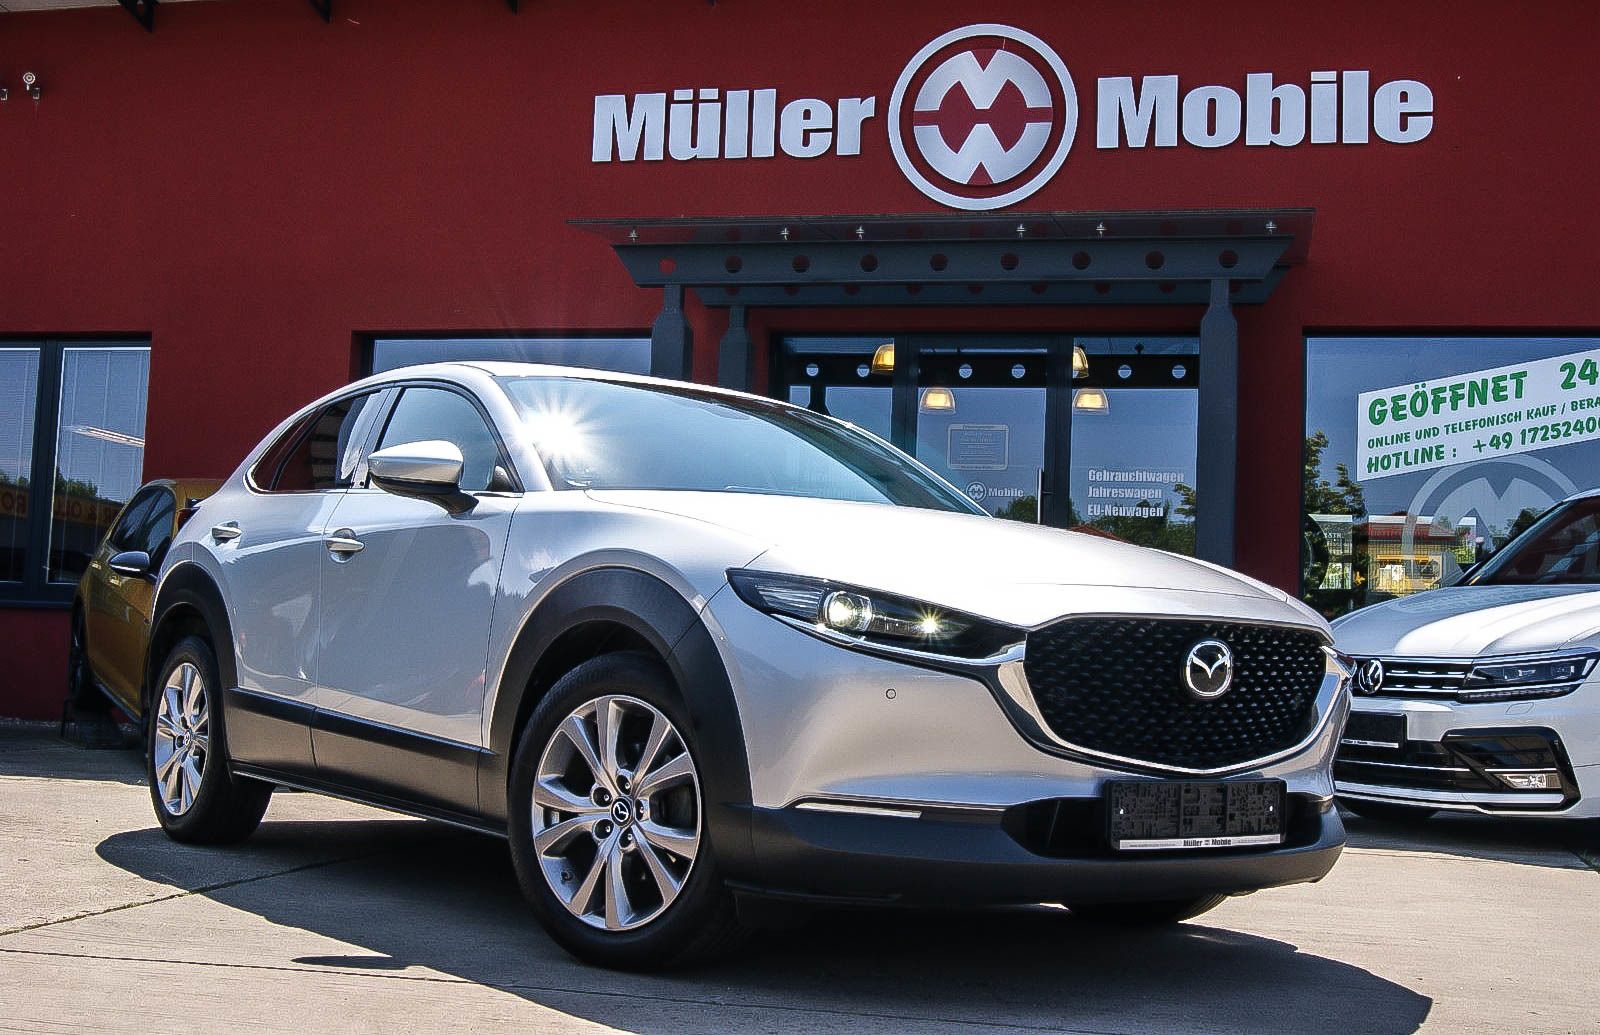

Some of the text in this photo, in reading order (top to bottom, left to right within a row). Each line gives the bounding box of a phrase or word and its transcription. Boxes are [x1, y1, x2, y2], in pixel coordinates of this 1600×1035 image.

[592, 70, 1433, 162] Müller Mobile
[1368, 358, 1599, 426] GEÖFFNET 24
[1367, 431, 1411, 449] ONLINE
[1414, 426, 1440, 441] UND
[1444, 410, 1523, 435] TELEFONISCH
[1526, 404, 1557, 420] KAUF
[1366, 444, 1445, 473] HOTLINE
[1472, 431, 1513, 453] +49
[1088, 469, 1185, 484] Gebrauchtwagen
[988, 487, 1025, 498] Mobile
[1087, 486, 1163, 500] Jahreswagen
[1087, 504, 1164, 518] EU-Neuwagen
